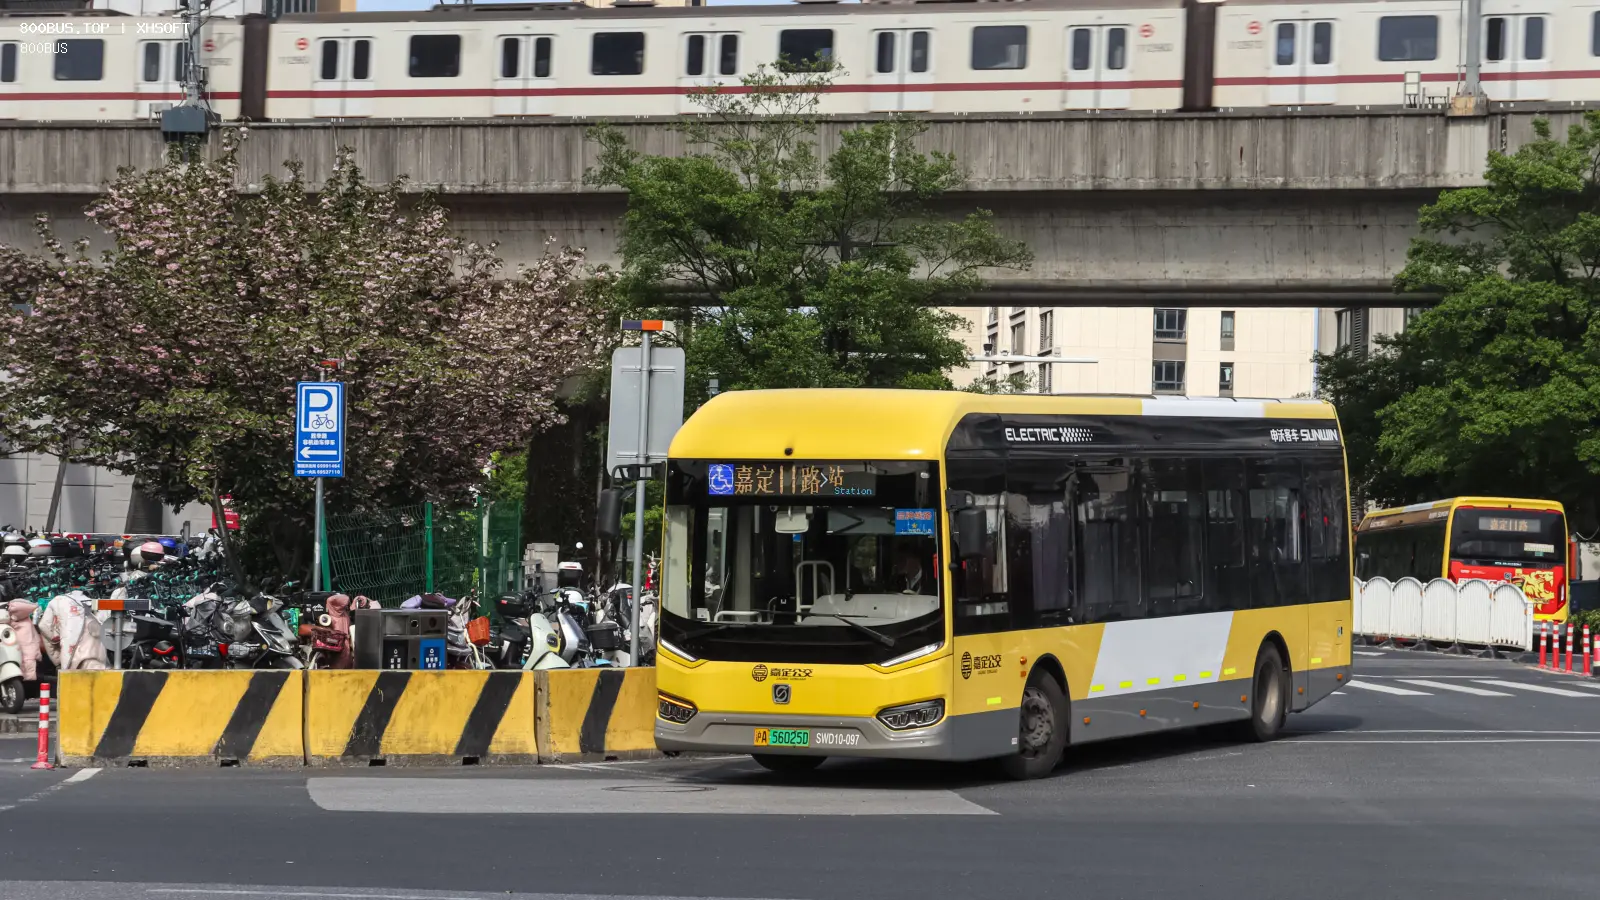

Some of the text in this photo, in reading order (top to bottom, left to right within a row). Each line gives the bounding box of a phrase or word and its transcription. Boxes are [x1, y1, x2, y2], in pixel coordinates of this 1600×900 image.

[304, 389, 333, 428] P
[1004, 427, 1059, 442] ELECTRIC
[1270, 428, 1339, 443] 申沃客车 SUNWIN
[735, 464, 845, 495] 嘉定11路 站
[834, 486, 873, 495] Station
[973, 654, 1002, 670] 嘉定公交
[770, 668, 814, 678] 嘉定公交
[771, 730, 809, 744] 56025D
[816, 732, 860, 745] SWD10-097
